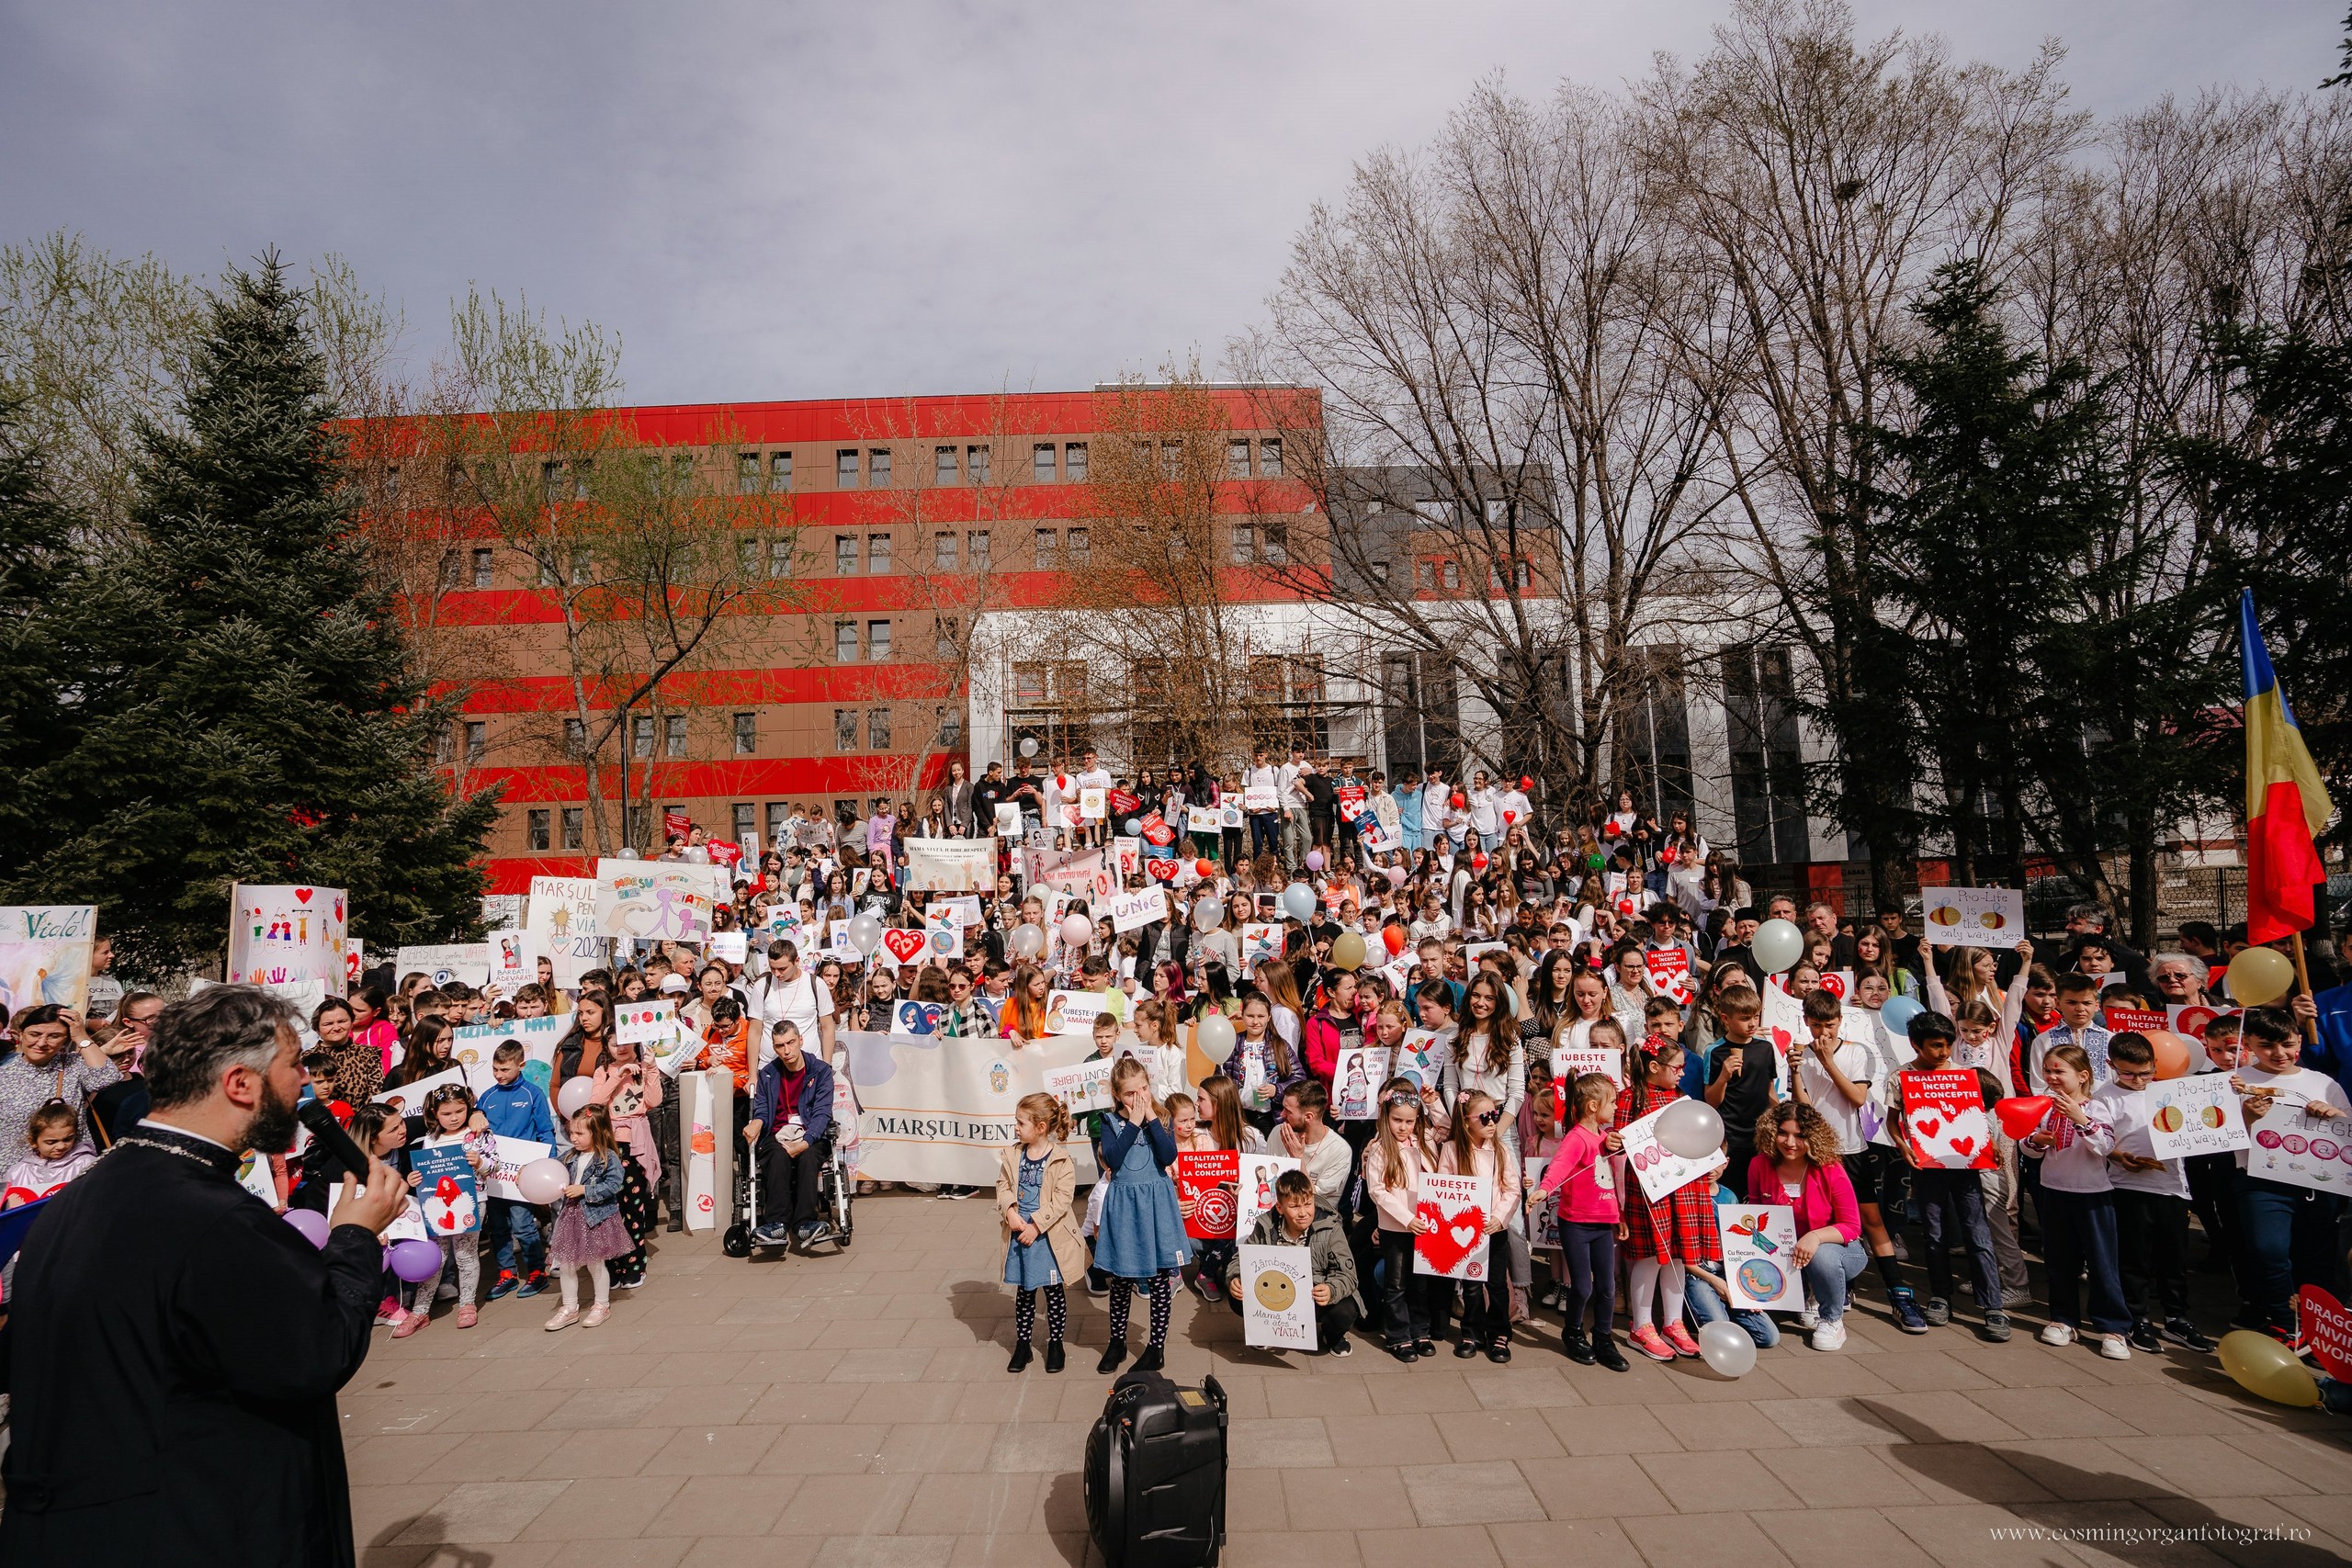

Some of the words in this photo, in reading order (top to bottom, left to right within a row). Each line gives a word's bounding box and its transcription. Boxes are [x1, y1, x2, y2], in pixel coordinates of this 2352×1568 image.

[1958, 889, 2008, 902] Pro-Life
[576, 902, 596, 916] PEN
[1966, 905, 1977, 916] is
[1962, 918, 1980, 930] the
[1940, 929, 1962, 942] only
[1967, 931, 1990, 942] way
[1992, 936, 2003, 946] to
[2002, 931, 2021, 941] bee
[571, 937, 607, 958] 2024
[1066, 1017, 1093, 1025] AMÂND
[2127, 1020, 2162, 1030] ÎNCEPE
[1561, 1054, 1607, 1064] IUBEȘTE
[1052, 1074, 1082, 1087] IUBIRE
[1084, 1067, 1110, 1082] SUNT
[1923, 1082, 1958, 1090] ÎNCEPE
[2177, 1076, 2223, 1097] Pro-Life
[1924, 1091, 1979, 1100] CONCEPȚIE
[2186, 1101, 2198, 1113] is
[876, 1117, 965, 1140] MARȘUL
[967, 1122, 1018, 1141] PENT
[2185, 1118, 2203, 1133] the
[2168, 1134, 2192, 1150] only
[2193, 1134, 2217, 1146] way
[2225, 1128, 2245, 1140] bee
[1194, 1161, 1222, 1169] ÎNCEPE
[1194, 1169, 1238, 1178] CONCEPȚIE
[1427, 1179, 1476, 1191] IUBEȘTE
[1435, 1190, 1471, 1203] VIAȚA
[1287, 1312, 1297, 1321] ta
[2315, 1317, 2352, 1348] ÎNVI
